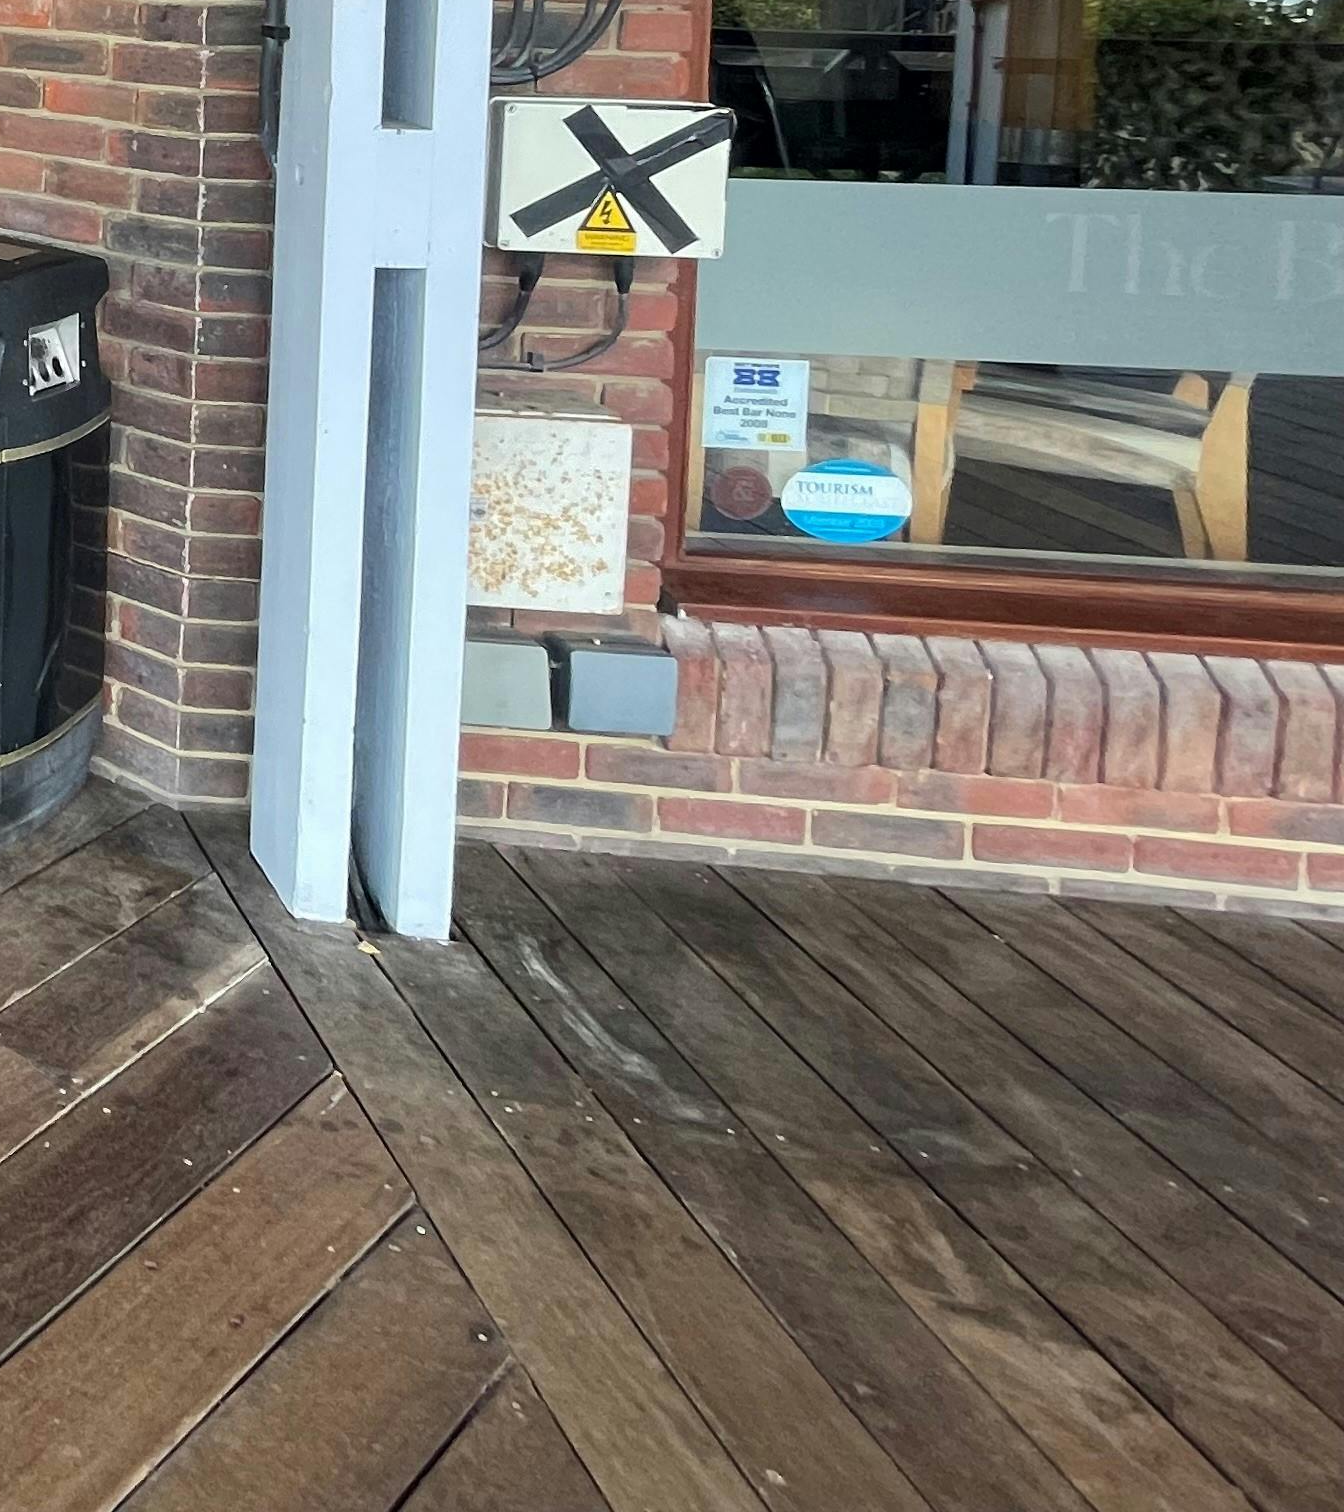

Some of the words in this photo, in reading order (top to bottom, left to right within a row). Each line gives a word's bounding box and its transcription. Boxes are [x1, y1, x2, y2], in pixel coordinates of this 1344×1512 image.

[723, 395, 789, 407] Accredited
[713, 406, 739, 416] Best
[742, 407, 762, 416] Bar
[766, 408, 796, 419] None
[796, 480, 874, 496] TOURISM
